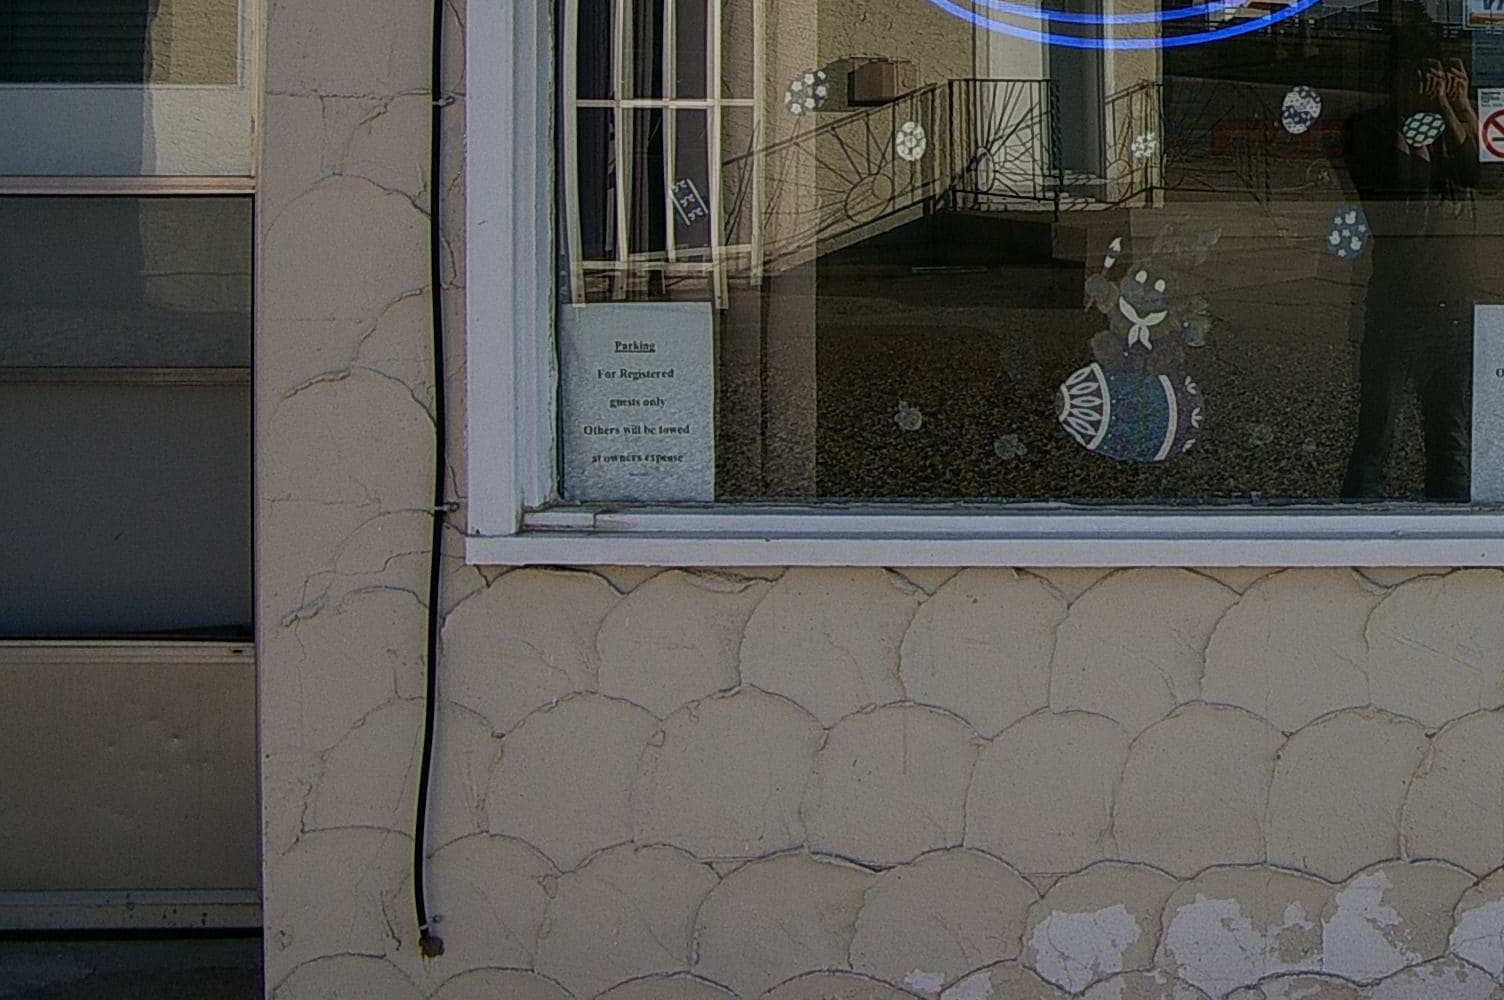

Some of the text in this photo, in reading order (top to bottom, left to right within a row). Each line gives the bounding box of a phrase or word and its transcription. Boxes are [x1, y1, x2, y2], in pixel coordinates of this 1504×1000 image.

[614, 340, 656, 353] Parking
[597, 368, 674, 381] For Registered
[609, 396, 666, 409] guests only
[583, 424, 690, 435] Others will be towed
